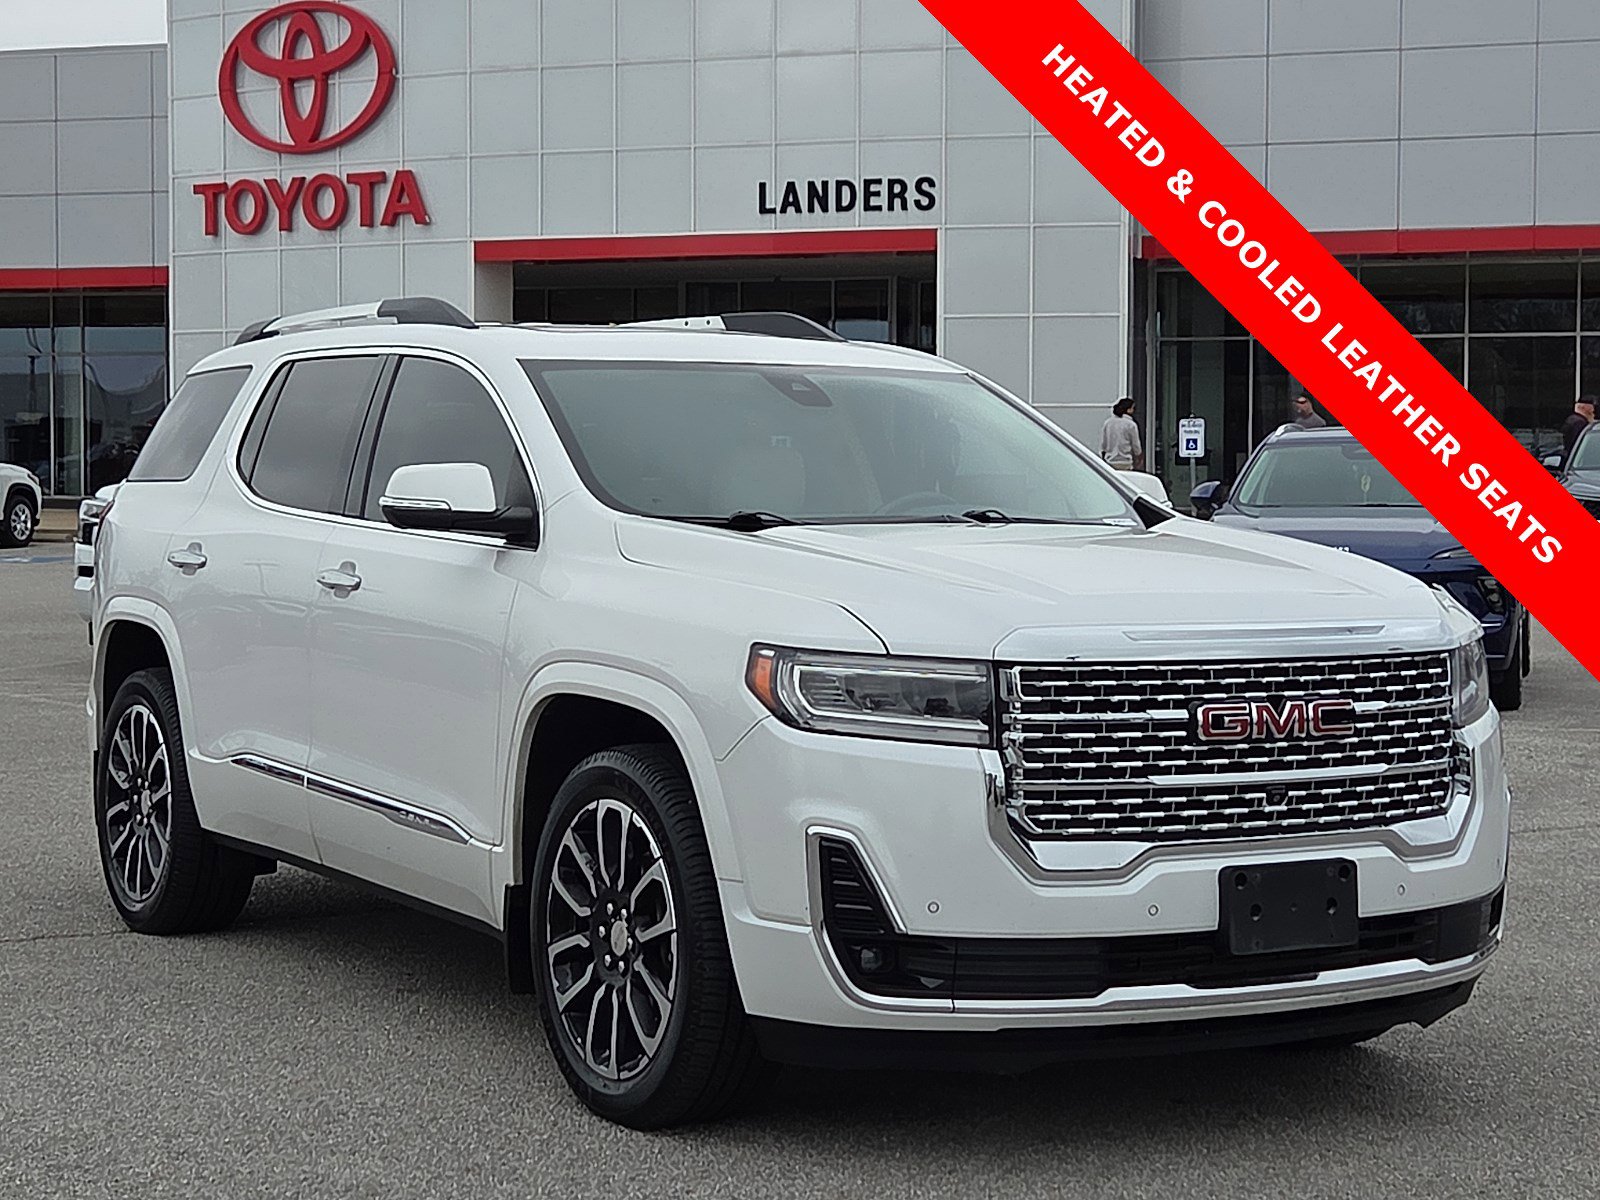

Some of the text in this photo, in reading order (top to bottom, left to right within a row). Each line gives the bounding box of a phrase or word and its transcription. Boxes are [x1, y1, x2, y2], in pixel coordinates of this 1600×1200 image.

[193, 169, 430, 237] TOYOTA
[758, 176, 937, 215] LANDERS
[1197, 699, 1354, 741] GMC
